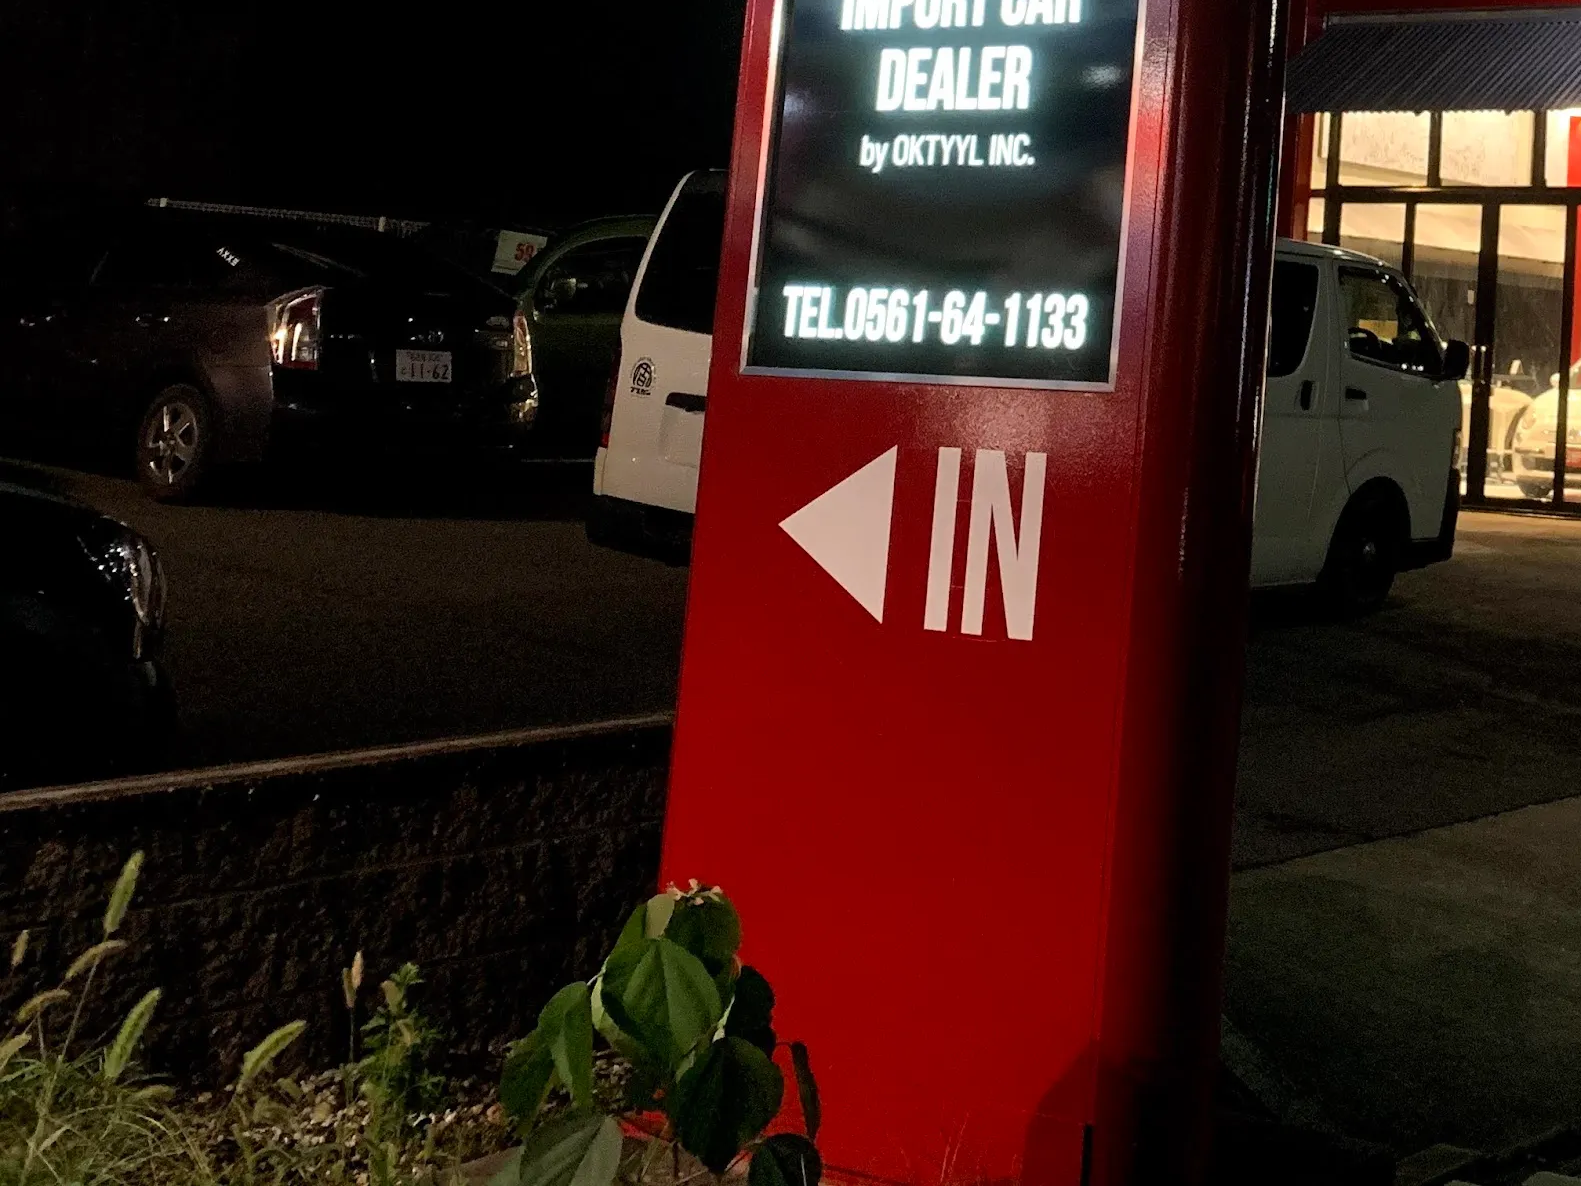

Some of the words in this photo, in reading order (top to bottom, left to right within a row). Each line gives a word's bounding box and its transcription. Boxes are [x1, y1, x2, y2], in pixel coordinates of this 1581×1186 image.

[875, 45, 1033, 112] DEALER
[859, 134, 888, 174] by
[892, 134, 983, 167] OKTYYL
[988, 133, 1035, 166] INC.
[923, 446, 1048, 642] IN
